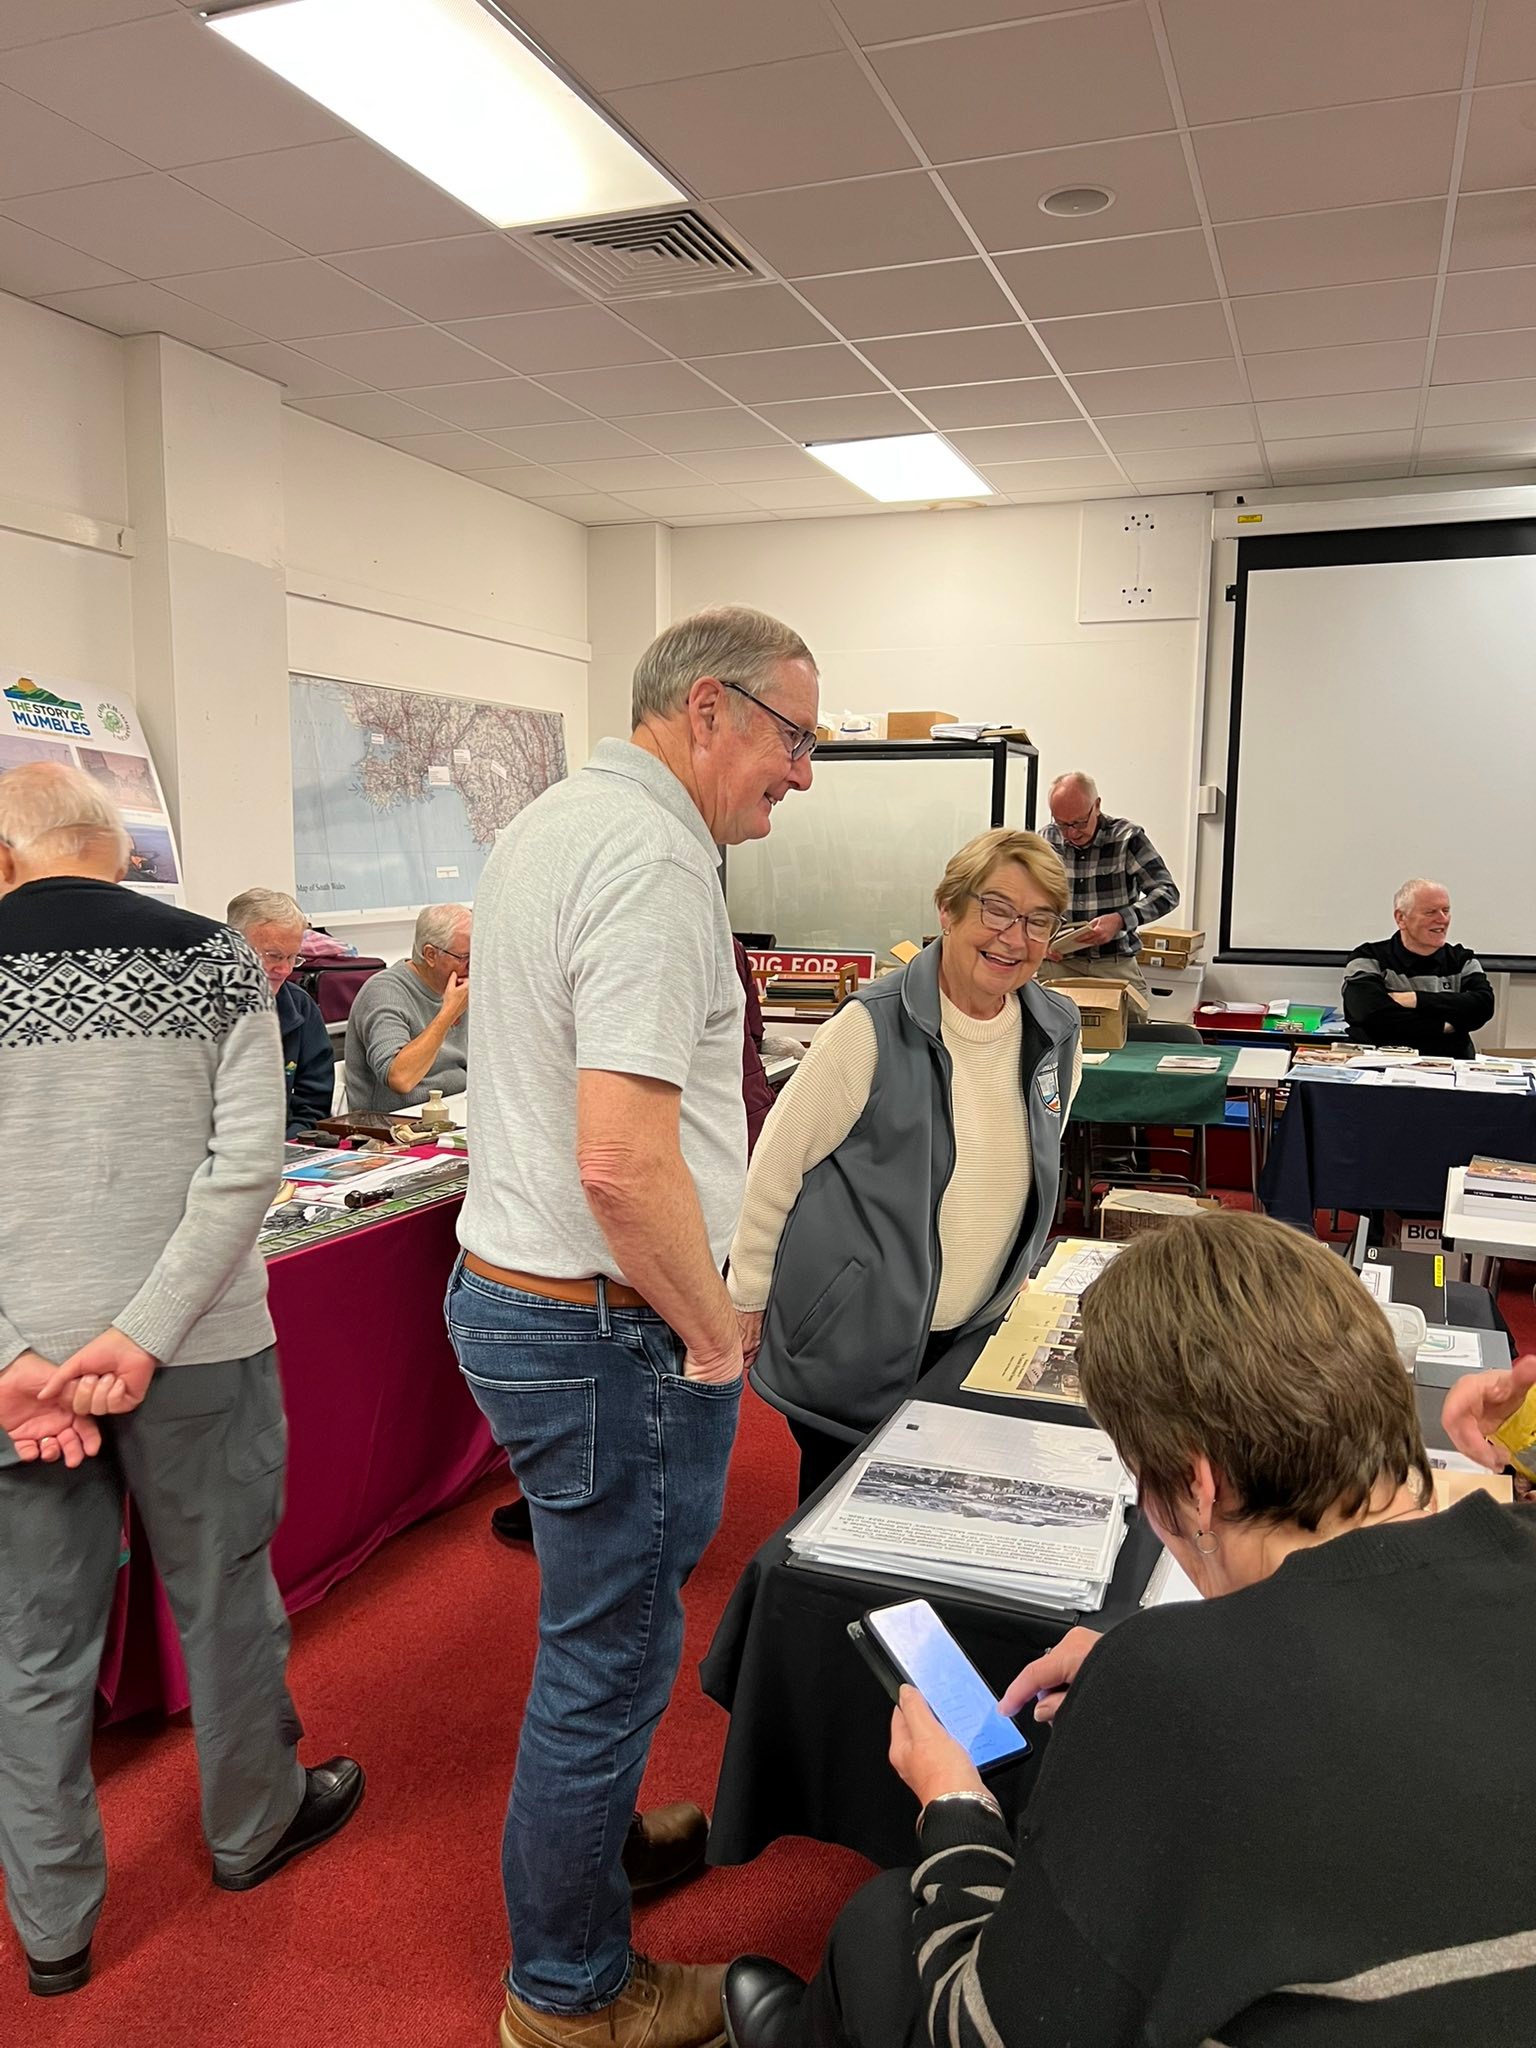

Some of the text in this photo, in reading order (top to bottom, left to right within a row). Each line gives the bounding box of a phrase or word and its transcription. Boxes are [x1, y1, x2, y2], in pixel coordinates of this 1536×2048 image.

[7, 699, 85, 721] THE STORY OF
[12, 711, 91, 736] MUMBLES
[747, 956, 839, 973] DIG FOR
[1407, 1224, 1441, 1239] Bla
